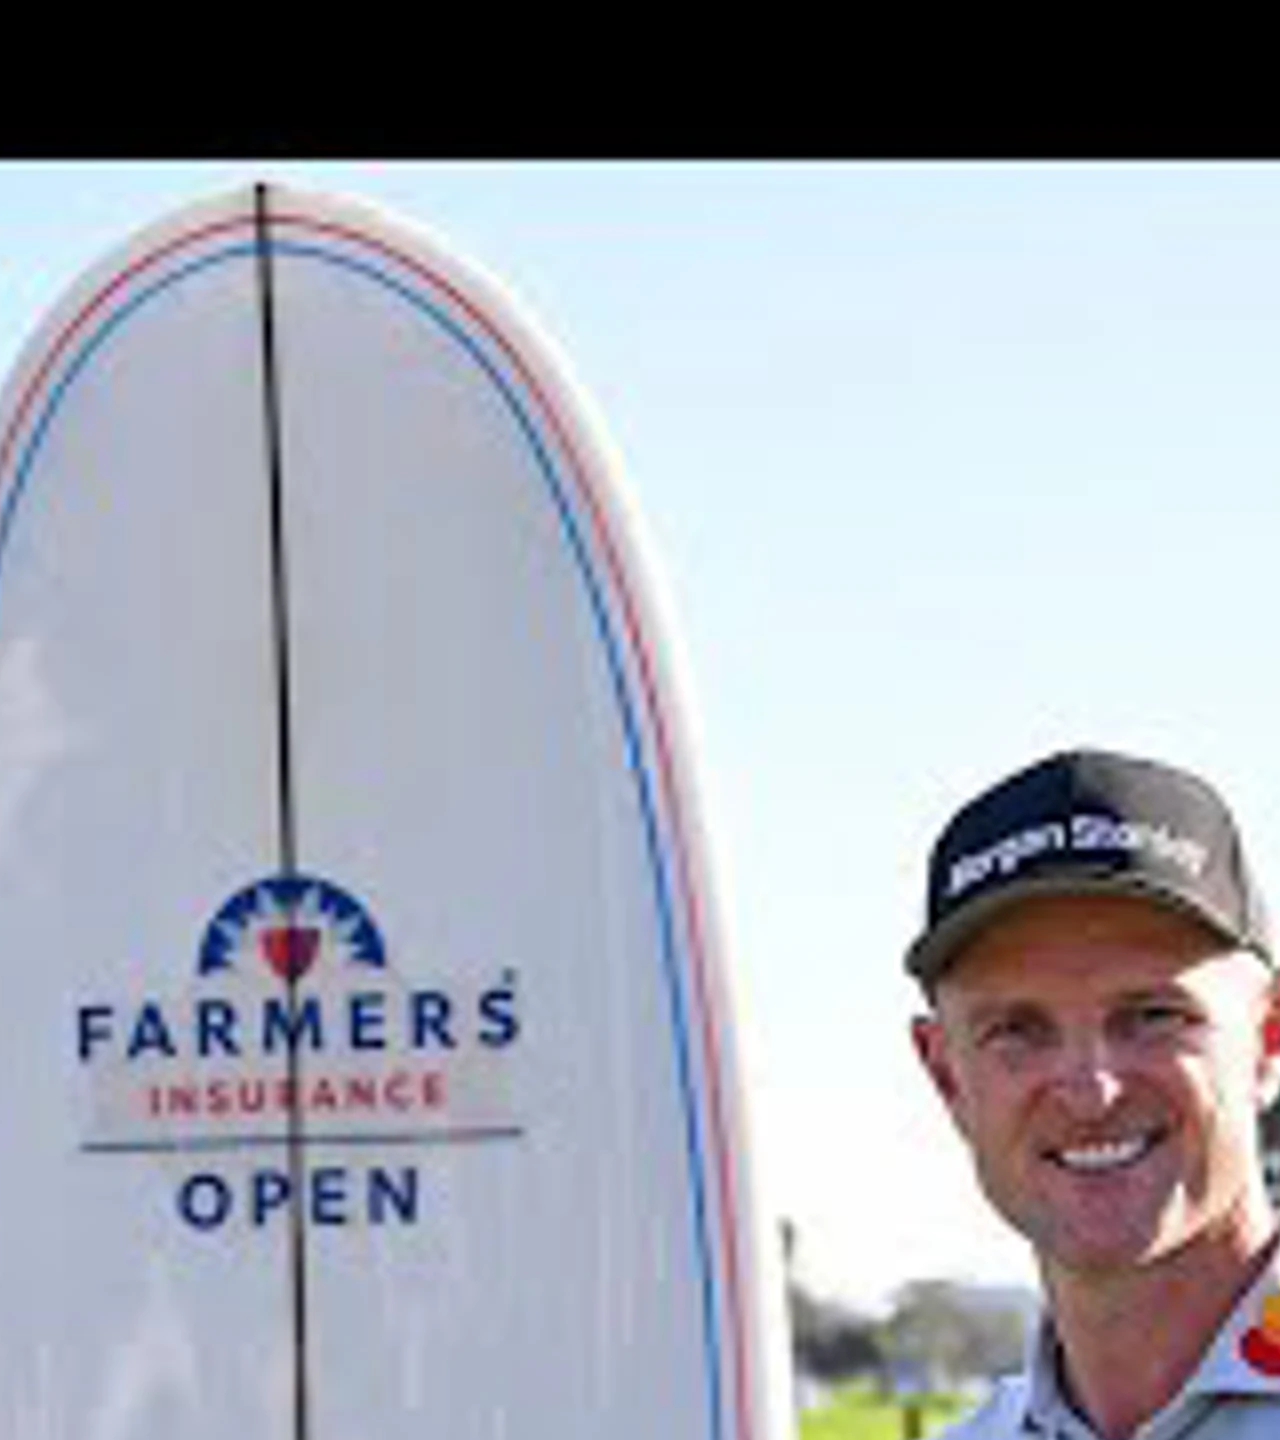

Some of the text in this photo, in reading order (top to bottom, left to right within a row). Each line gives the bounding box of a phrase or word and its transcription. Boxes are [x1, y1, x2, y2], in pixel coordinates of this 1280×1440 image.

[77, 990, 520, 1061] FARMERS
[150, 1071, 447, 1117] INSURANCE
[176, 1166, 419, 1230] OPEN
